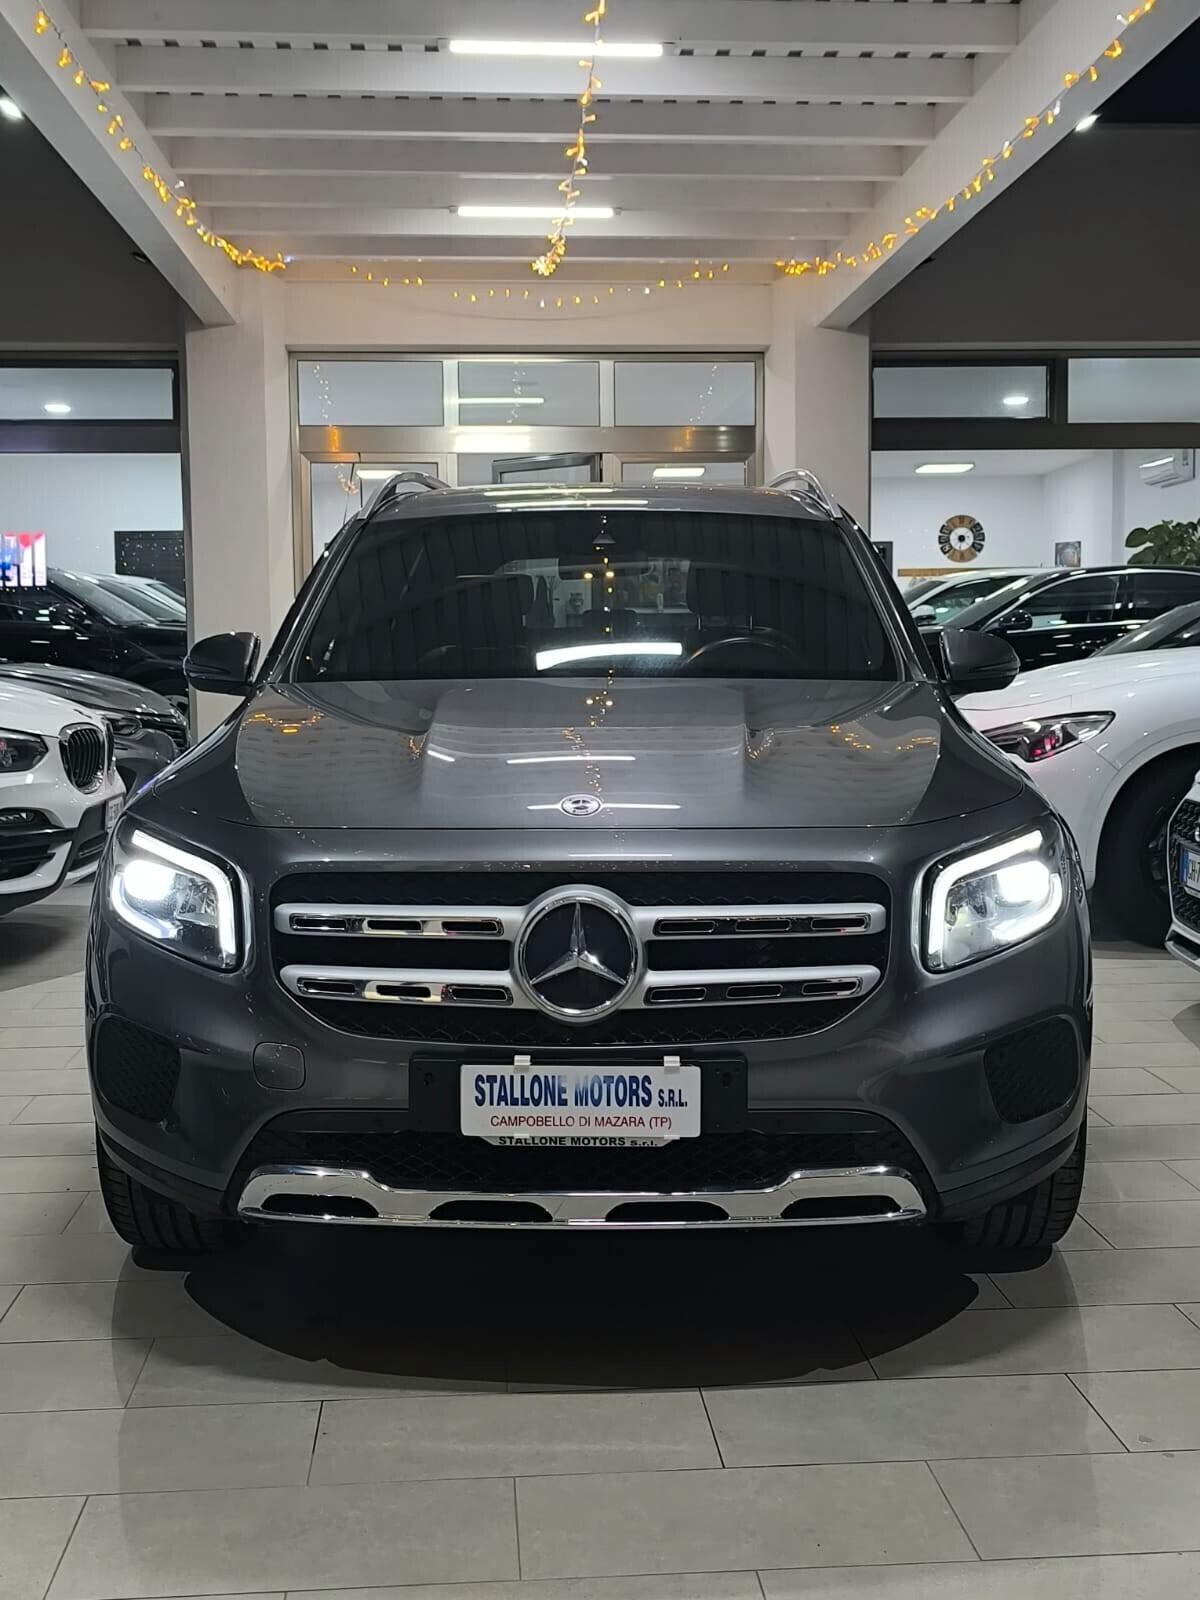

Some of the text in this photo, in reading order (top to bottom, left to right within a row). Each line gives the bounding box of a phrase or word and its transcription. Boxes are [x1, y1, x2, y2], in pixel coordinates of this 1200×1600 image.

[475, 1074, 688, 1108] STALLONE MOTORS S.R.L.
[490, 1115, 672, 1130] CAMPOBELLO DI MAZARA (TP)
[499, 1136, 566, 1146] STALLONE
[570, 1136, 626, 1147] MOTORS
